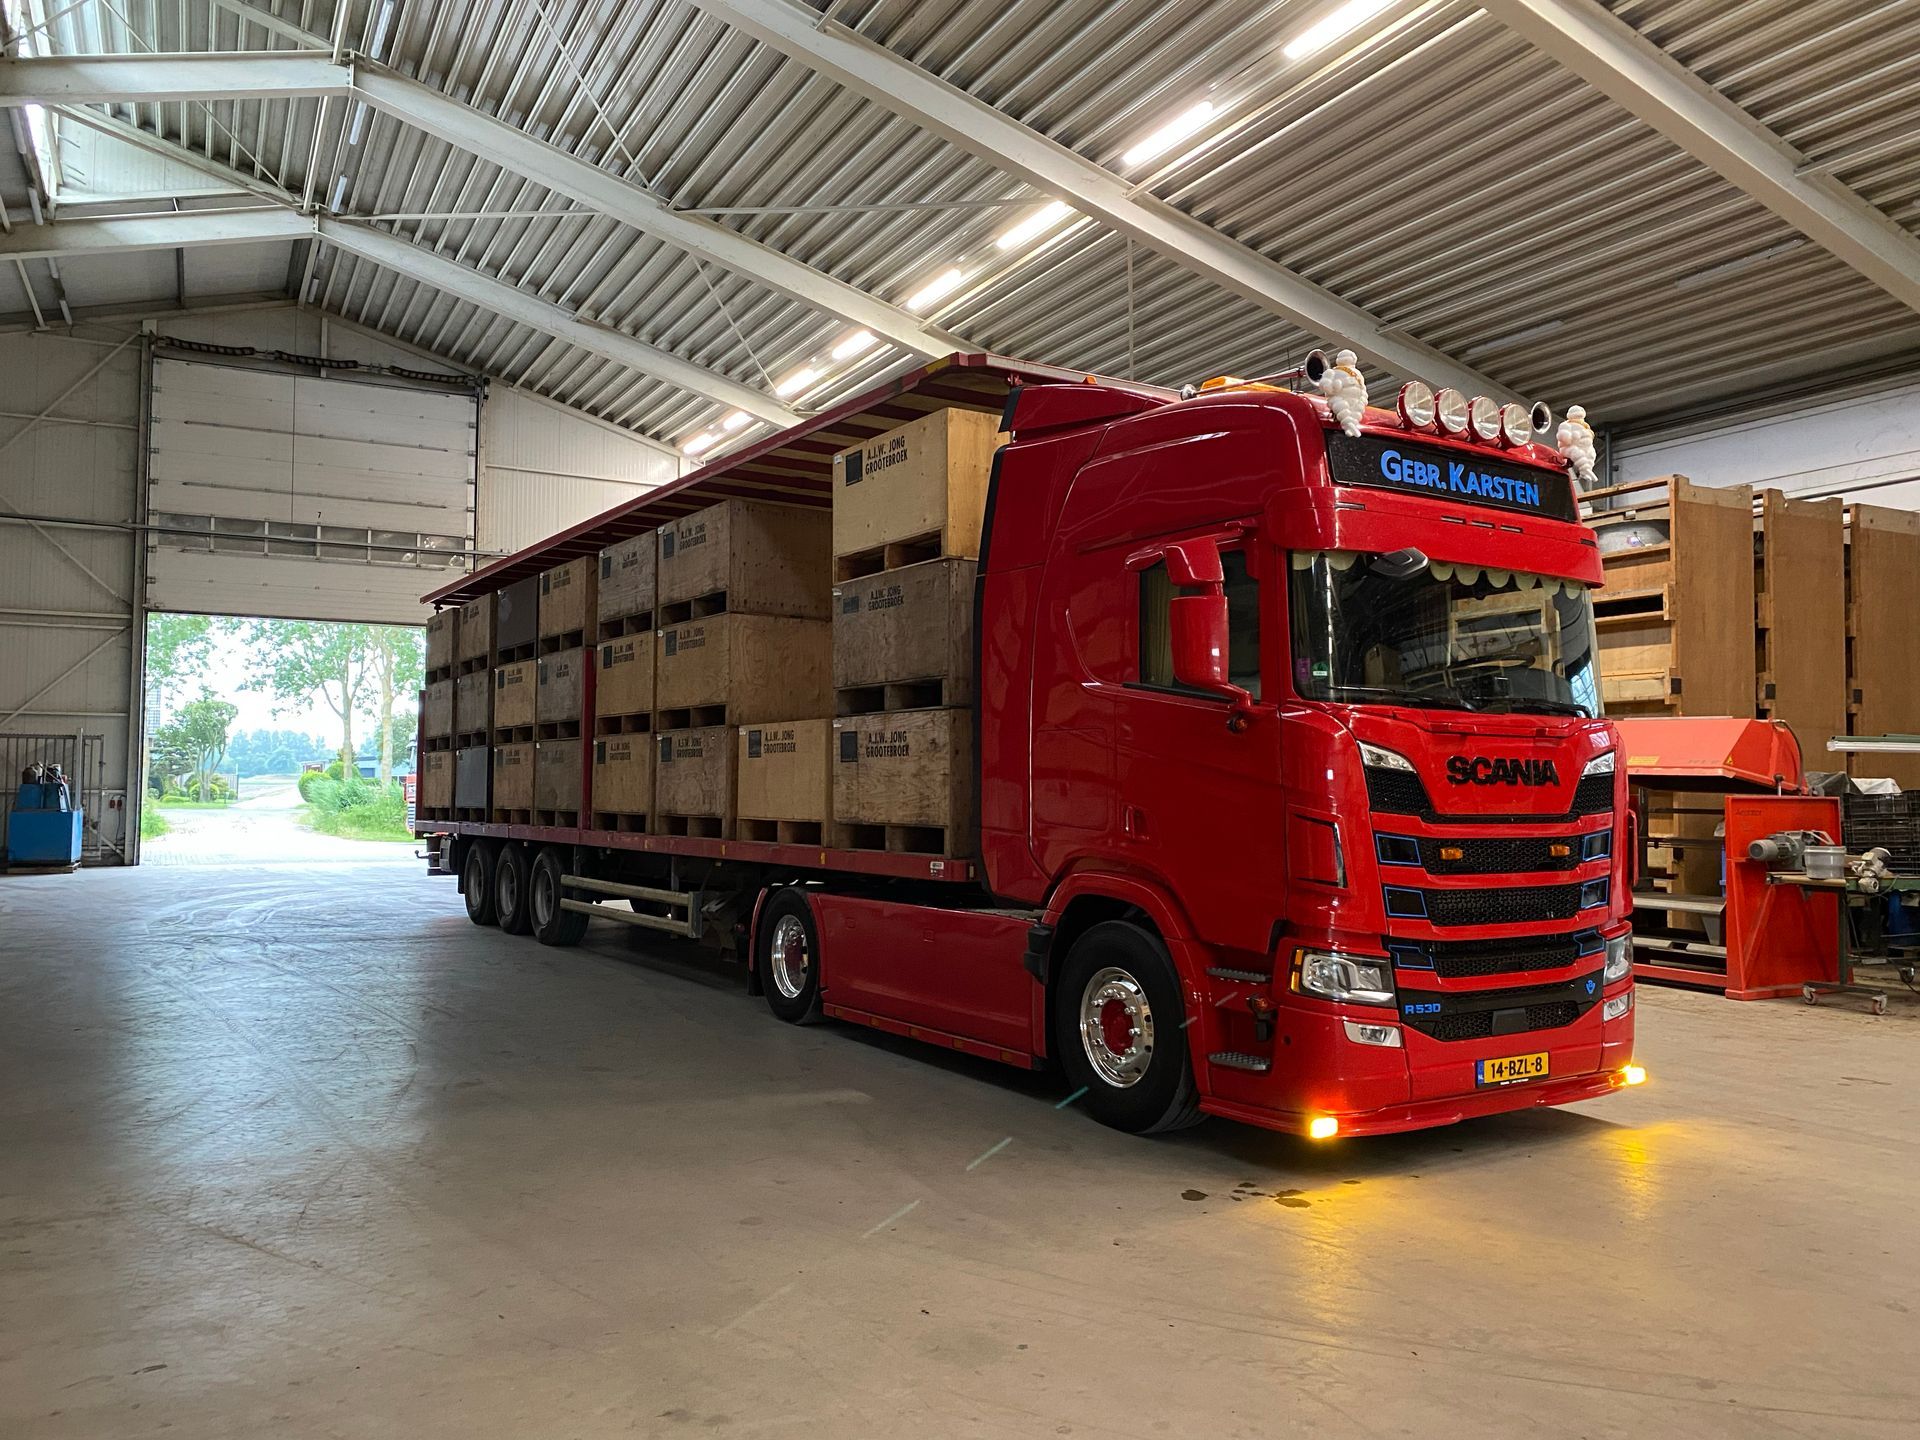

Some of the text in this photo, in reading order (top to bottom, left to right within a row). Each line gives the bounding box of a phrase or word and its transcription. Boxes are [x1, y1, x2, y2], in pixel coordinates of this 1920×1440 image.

[868, 436, 905, 460] A.J.W. JONG
[865, 448, 908, 475] GROOTEBROEK
[1380, 450, 1540, 506] GEBR. KARSTEN
[782, 730, 794, 741] JONG
[868, 731, 907, 745] A.J.W. JONG
[866, 745, 910, 758] GROOTEBROEK
[1446, 756, 1560, 787] SCANIA
[1491, 1056, 1543, 1080] 14-BZL-8
